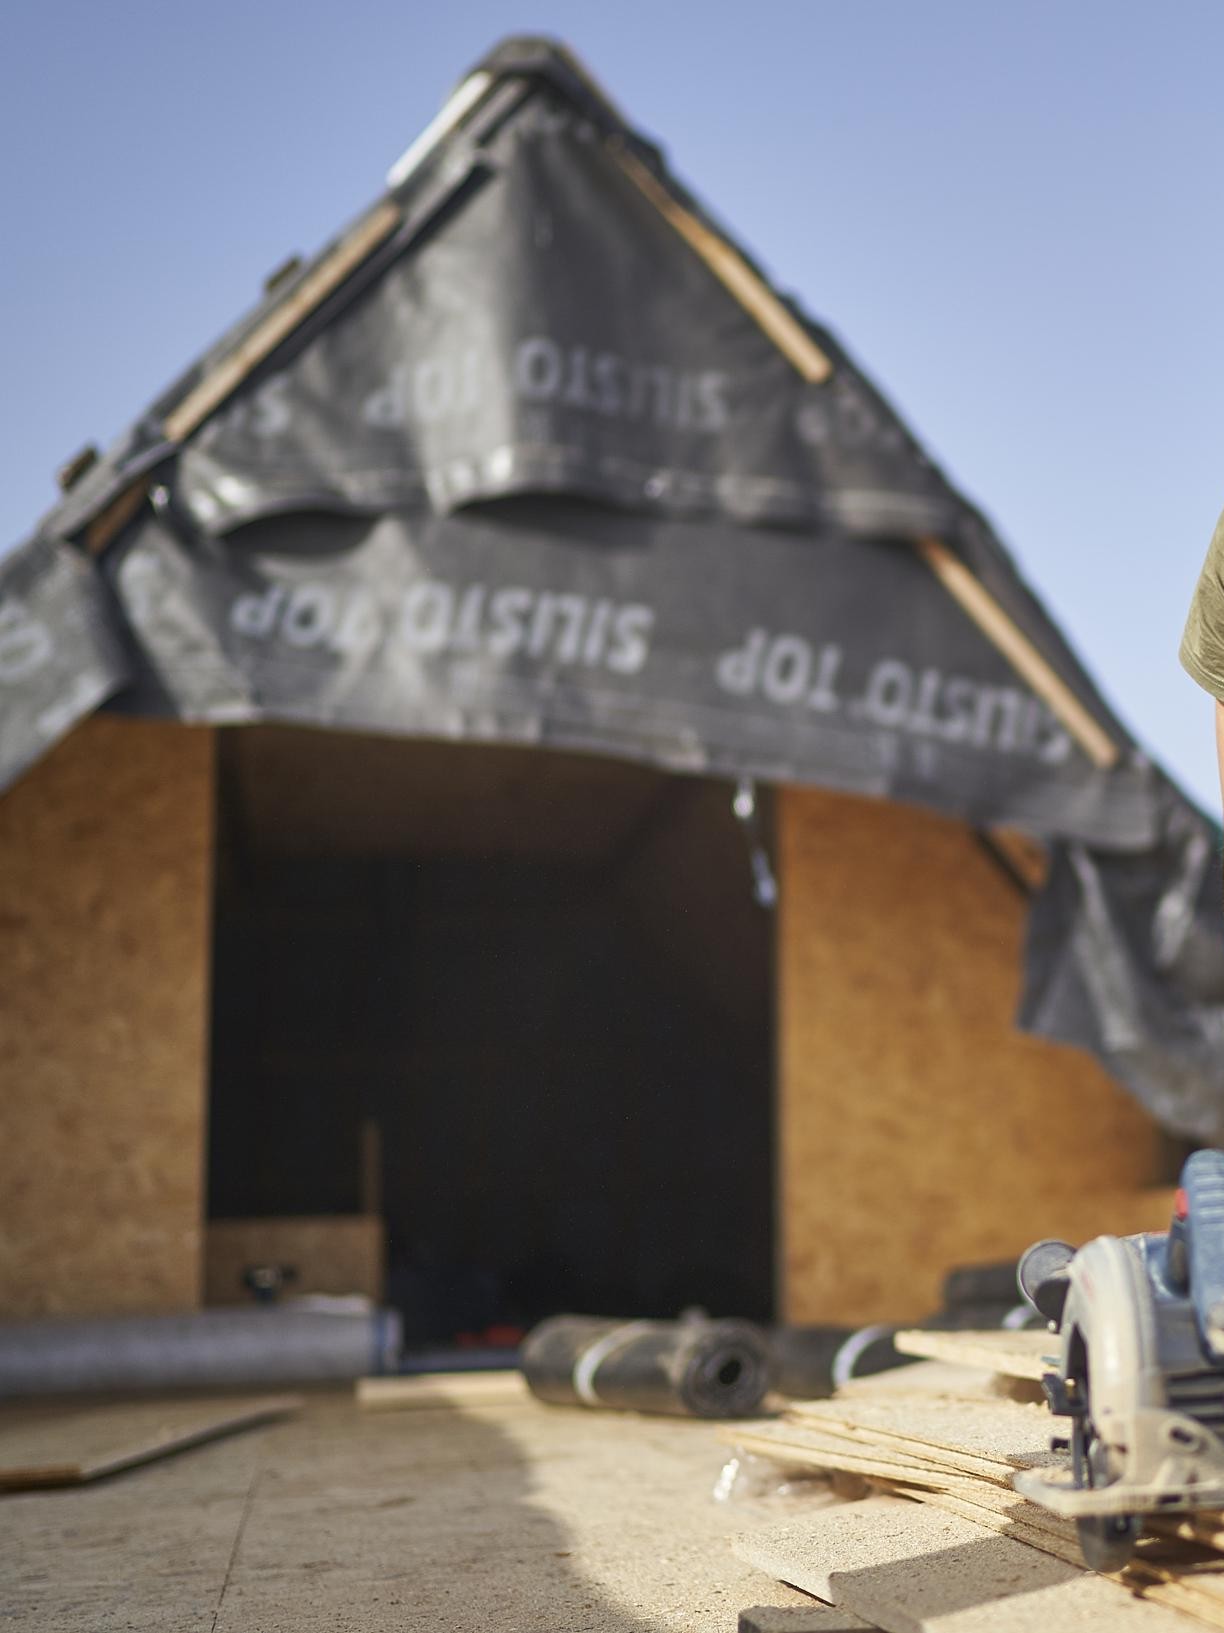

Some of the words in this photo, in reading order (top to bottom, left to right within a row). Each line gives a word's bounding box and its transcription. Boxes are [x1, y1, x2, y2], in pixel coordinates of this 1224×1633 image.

[230, 583, 377, 655] TOP
[401, 580, 655, 675] SILISTO
[717, 628, 842, 713] TOP
